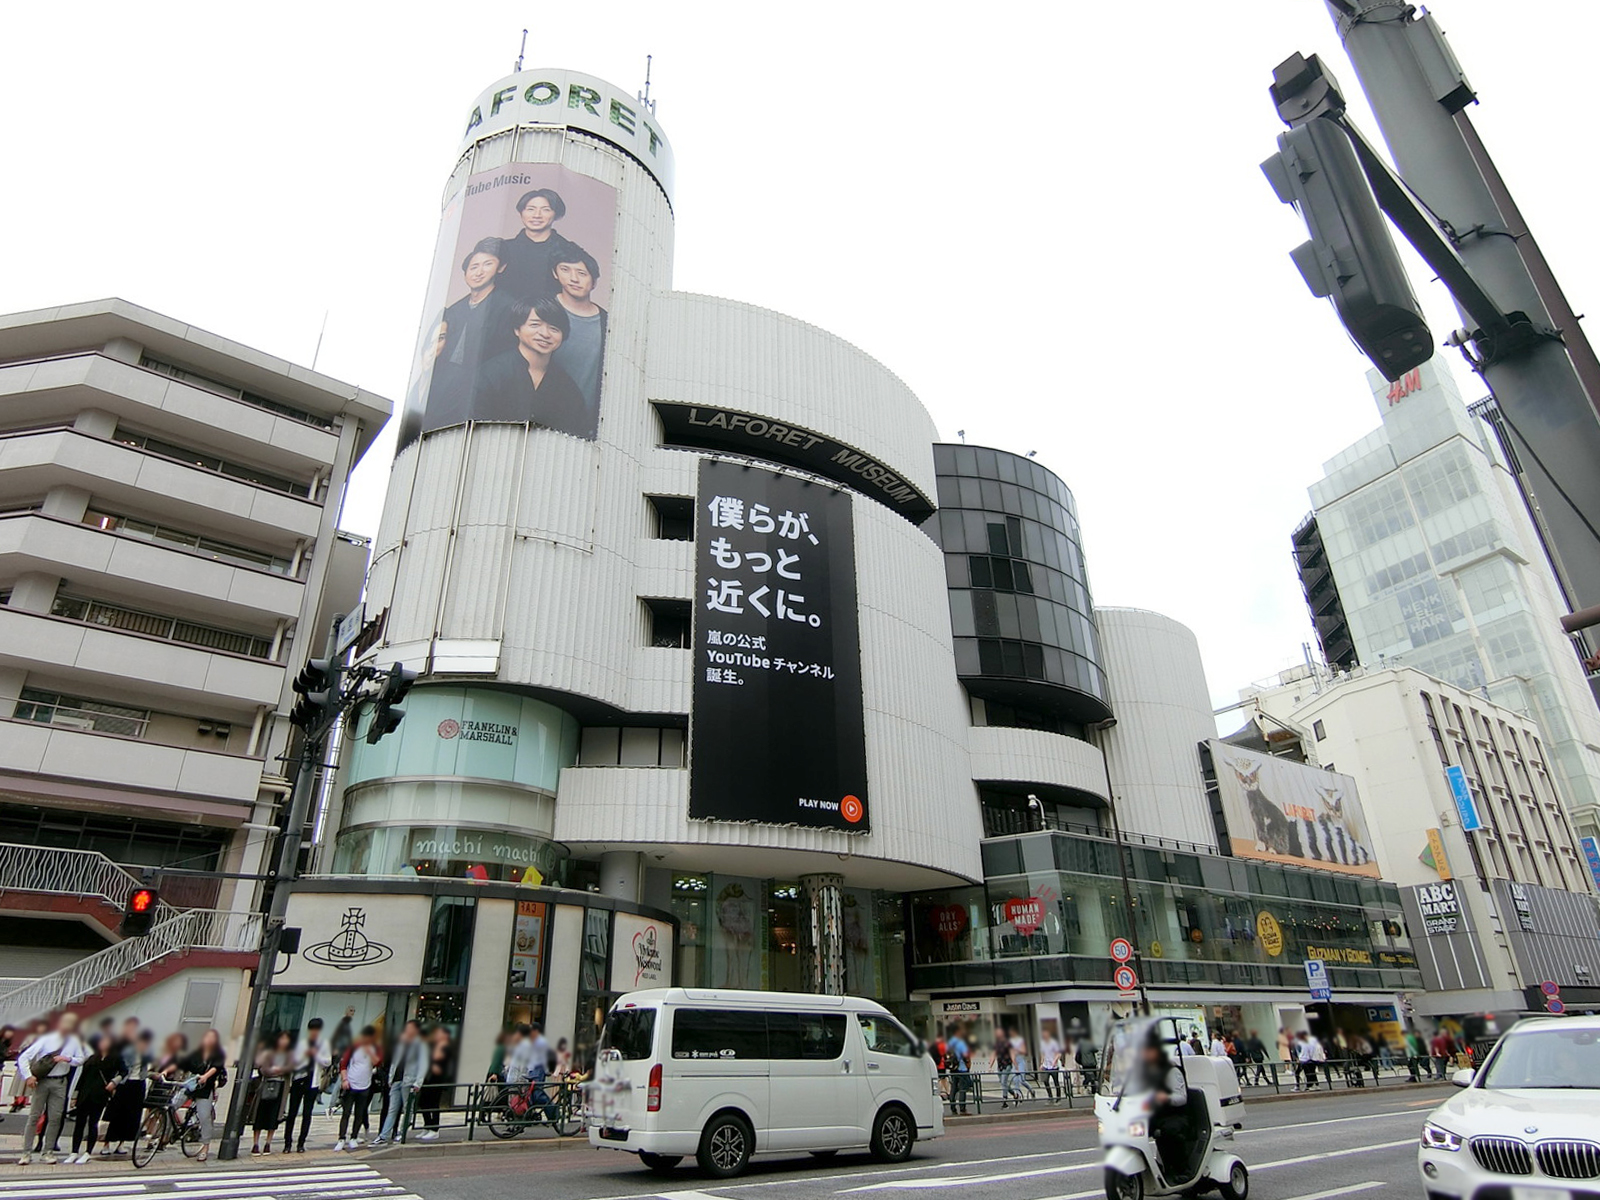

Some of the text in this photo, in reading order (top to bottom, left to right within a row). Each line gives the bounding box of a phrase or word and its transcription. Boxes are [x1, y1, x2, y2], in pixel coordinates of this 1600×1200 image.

[465, 173, 531, 197] Tube Music
[1386, 366, 1422, 407] H&M
[688, 408, 918, 504] LAFORET MUSEUM
[707, 494, 820, 546] 僕らが、
[710, 537, 801, 580] もっと
[706, 577, 821, 628] 近くに。
[706, 629, 767, 651] 嵐の公式
[707, 649, 835, 681] YouTube チャンネル
[705, 667, 744, 686] 誕生。
[459, 730, 513, 746] MARSHALL
[798, 798, 839, 811] PLAY NOW
[416, 834, 541, 864] machi machi
[1419, 883, 1454, 904] ABC
[1010, 903, 1040, 915] HUMAN
[1421, 900, 1457, 916] MART
[1426, 917, 1457, 928] GRAND
[1115, 944, 1127, 956] 50
